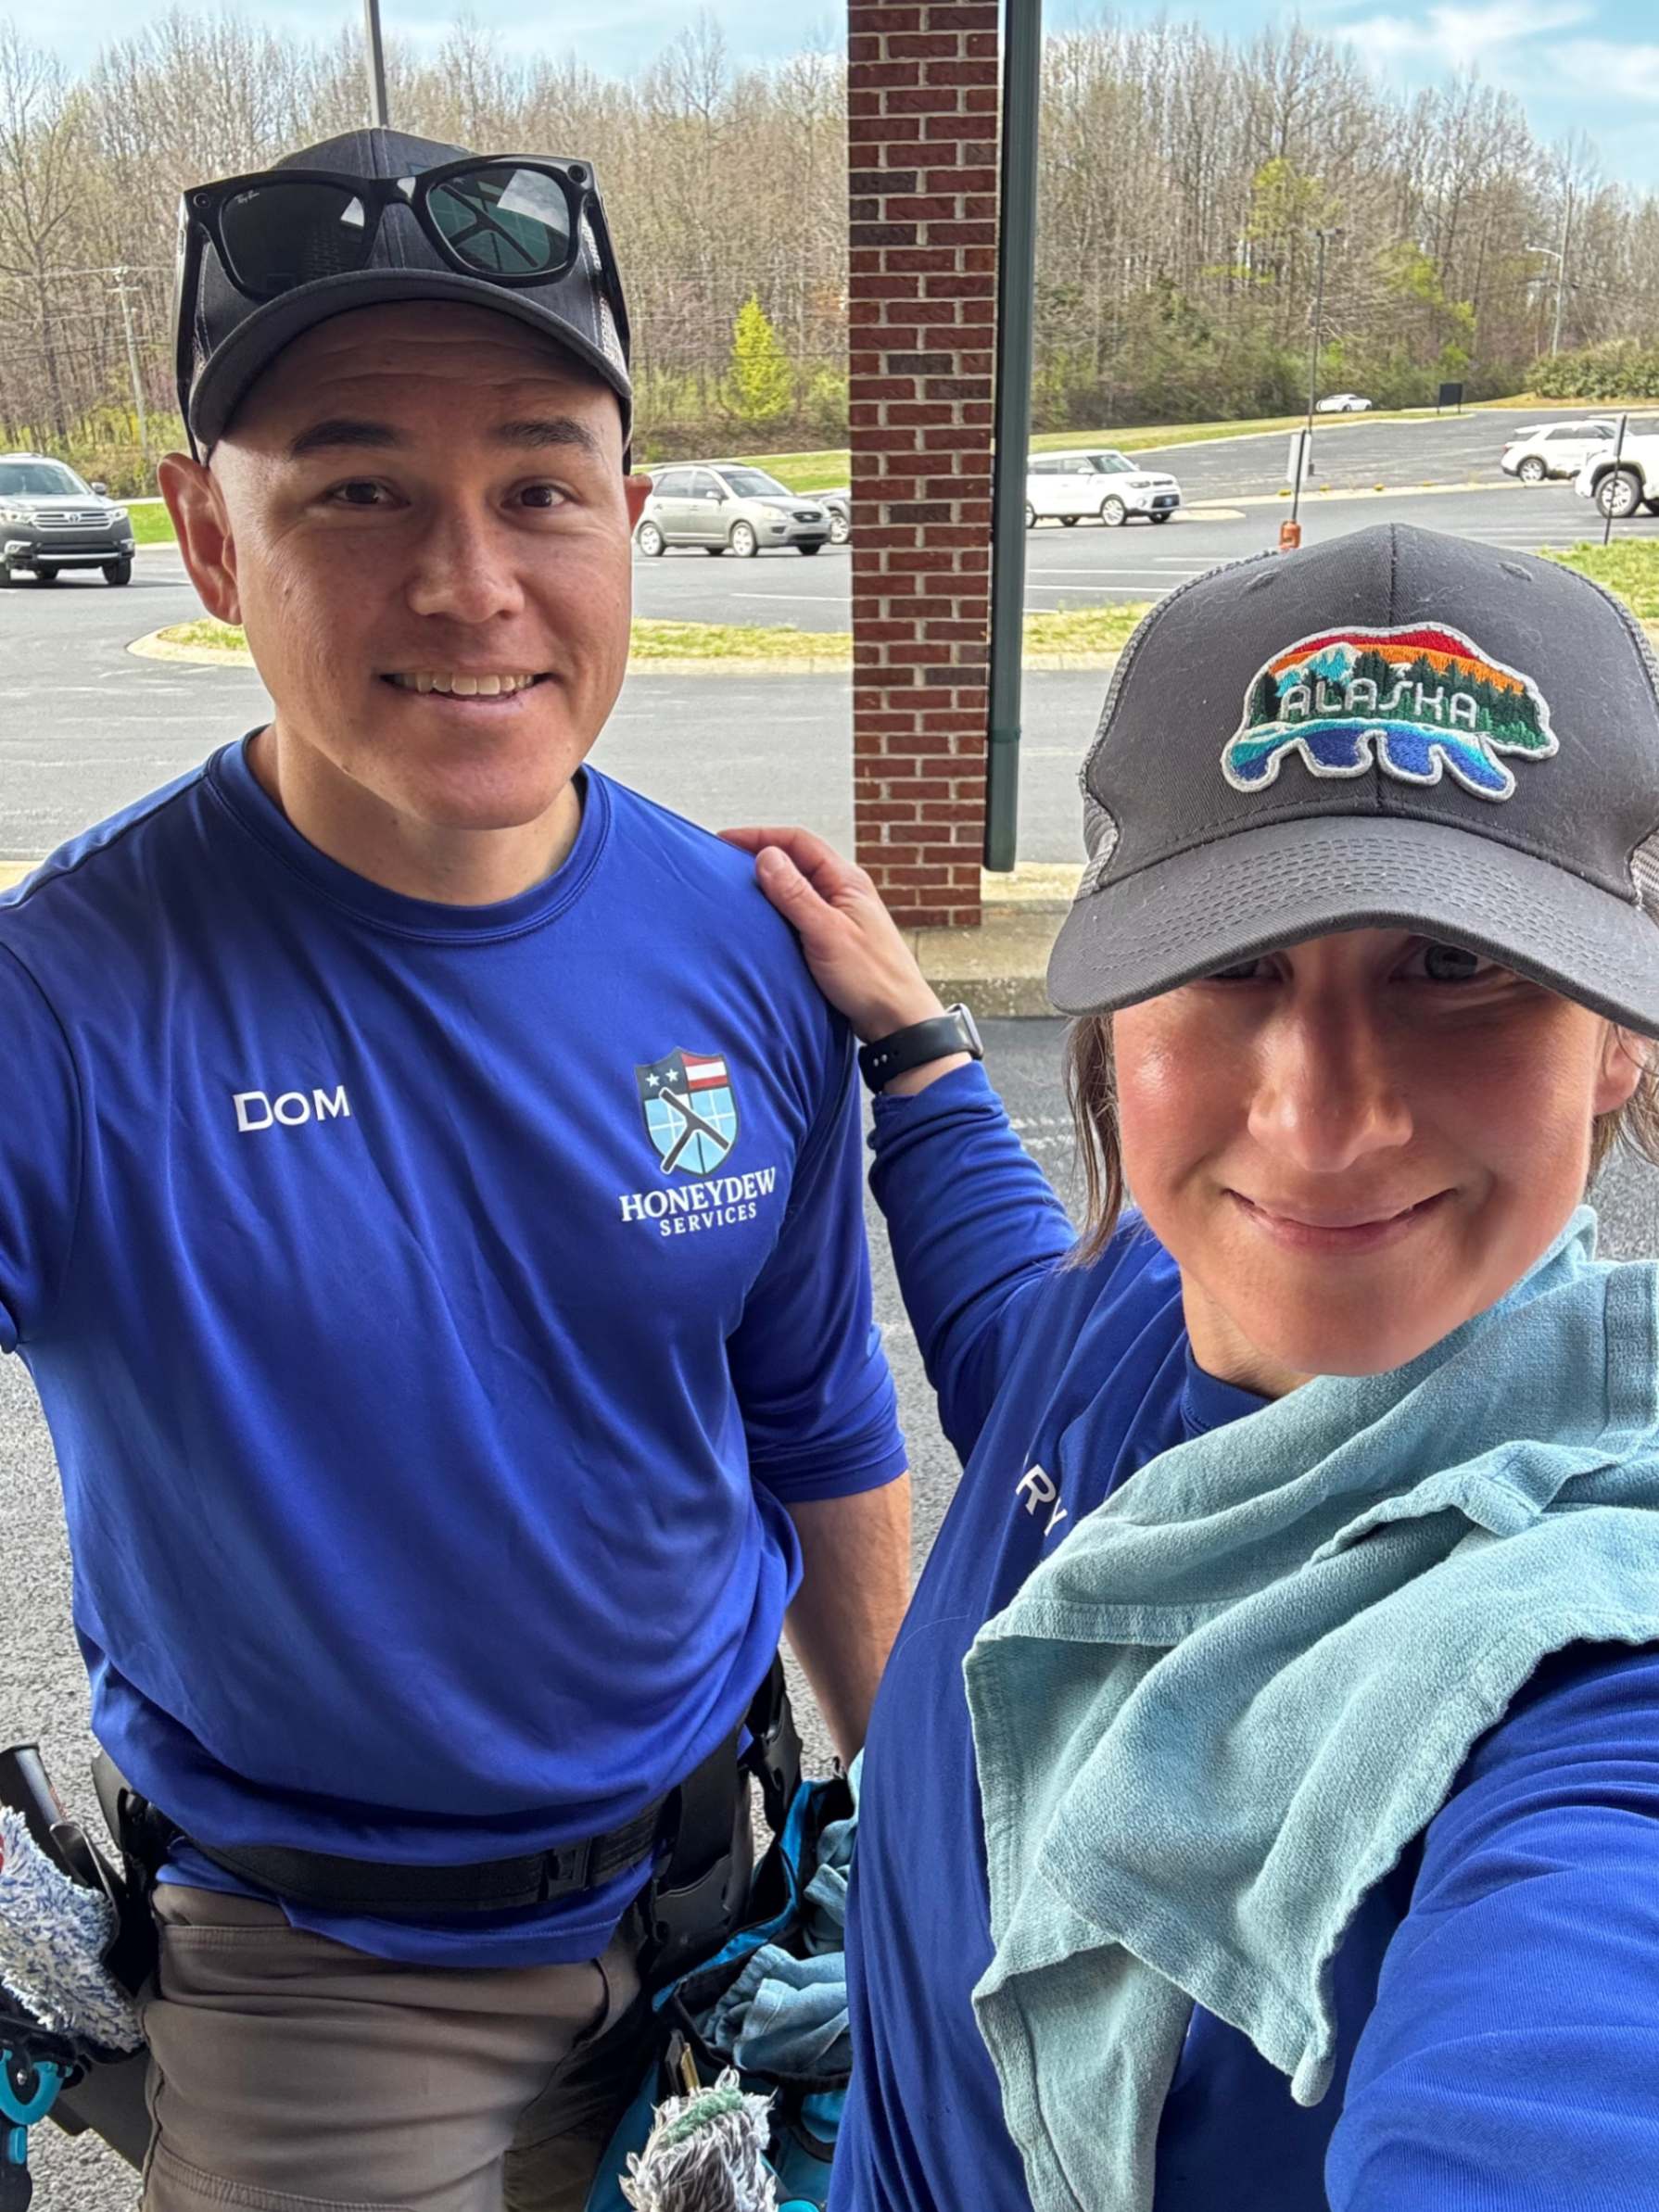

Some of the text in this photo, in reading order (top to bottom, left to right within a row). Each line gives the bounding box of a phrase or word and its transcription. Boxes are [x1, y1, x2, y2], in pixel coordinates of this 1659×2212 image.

[1279, 677, 1477, 728] ALASKA
[233, 1085, 350, 1132] DOM
[619, 1166, 776, 1221] HONEYDEW
[659, 1202, 757, 1236] SERVICES
